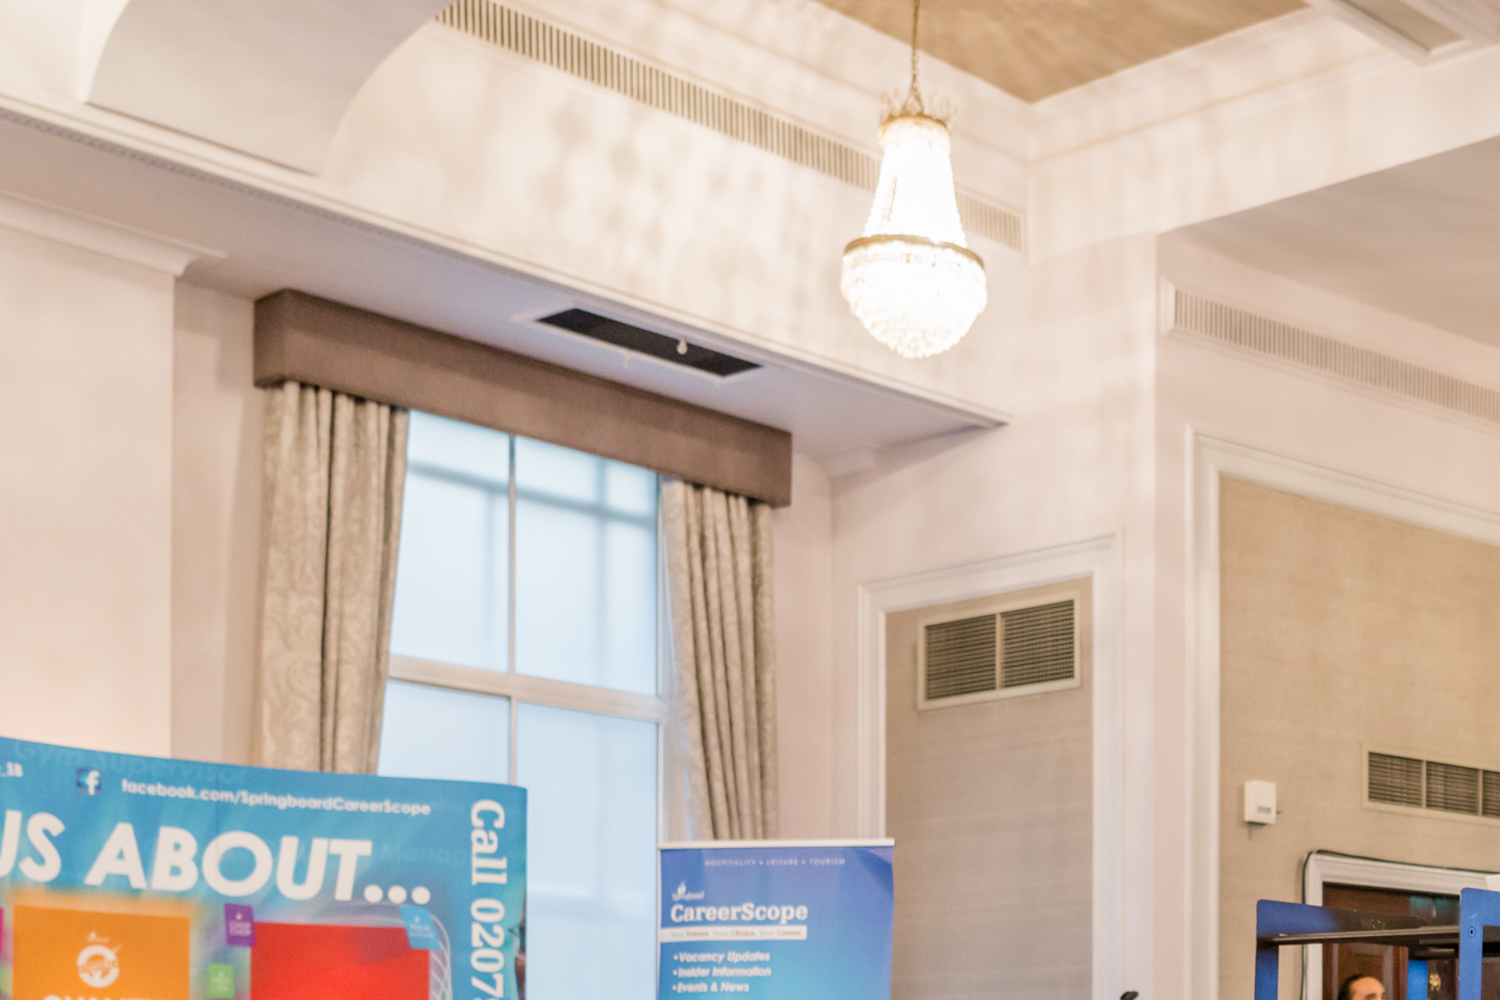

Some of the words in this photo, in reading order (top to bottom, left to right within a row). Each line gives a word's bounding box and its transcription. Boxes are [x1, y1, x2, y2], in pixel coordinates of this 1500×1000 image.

[470, 799, 507, 885] Call
[84, 821, 431, 905] ABOUT...
[670, 902, 808, 925] CareerScope
[679, 951, 725, 964] Vacancy
[727, 950, 770, 963] Updates
[677, 966, 710, 978] Insider
[712, 966, 772, 977] Information
[677, 982, 708, 993] Events
[710, 982, 718, 992] &
[720, 981, 749, 993] News
